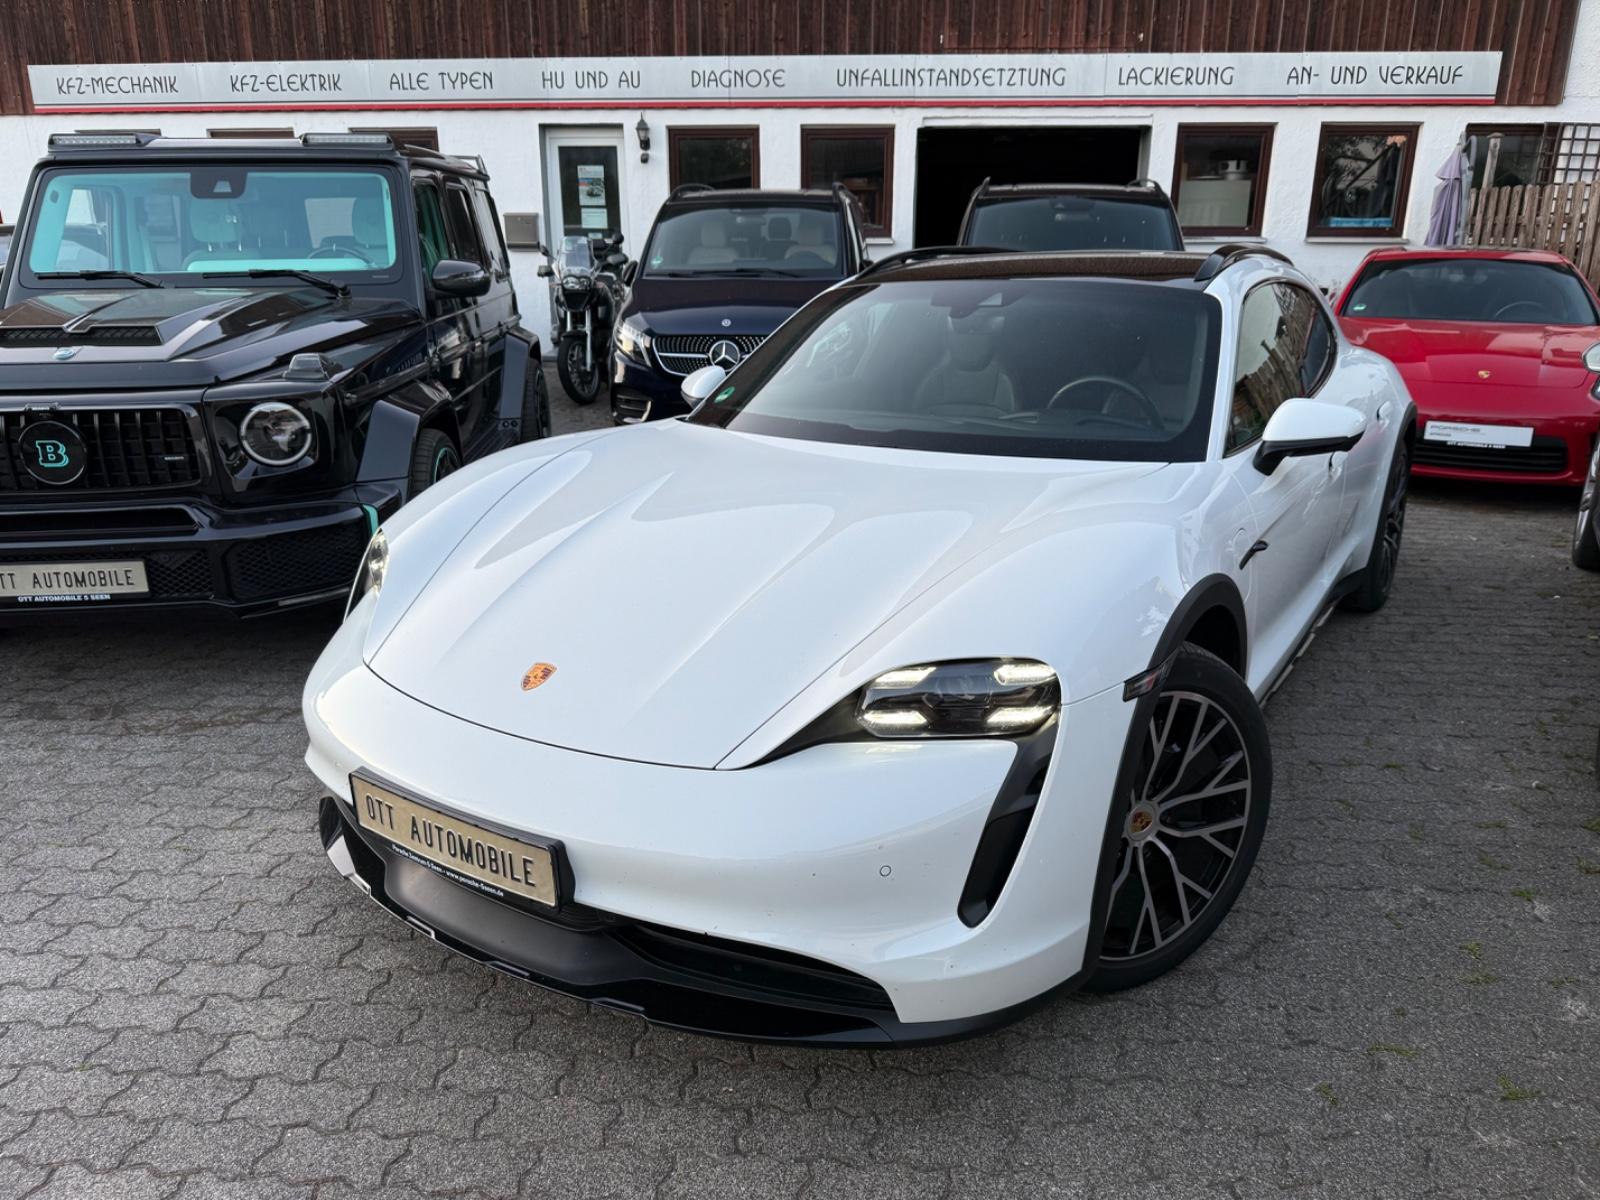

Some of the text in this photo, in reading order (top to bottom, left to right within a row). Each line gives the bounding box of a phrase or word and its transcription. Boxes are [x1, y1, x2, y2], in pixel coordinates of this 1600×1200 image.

[56, 75, 179, 95] KFZ-MECHANIK
[230, 73, 342, 93] KFZ-ELEKTRIK
[389, 71, 494, 91] ALLE TYPEN
[541, 70, 641, 90] HU UND AU
[691, 68, 786, 89] DIAGNOSE
[836, 67, 1066, 88] UNFALLINSTANDSETZTUNG
[1118, 66, 1235, 86] LACKIERUNG
[1286, 65, 1464, 85] AN- UND VERKAUF
[35, 440, 69, 467] B
[0, 569, 135, 590] TT AUTOMOBILE
[34, 594, 81, 603] AUTOMOBILE
[365, 792, 536, 887] OTT AUTOMOBILE
